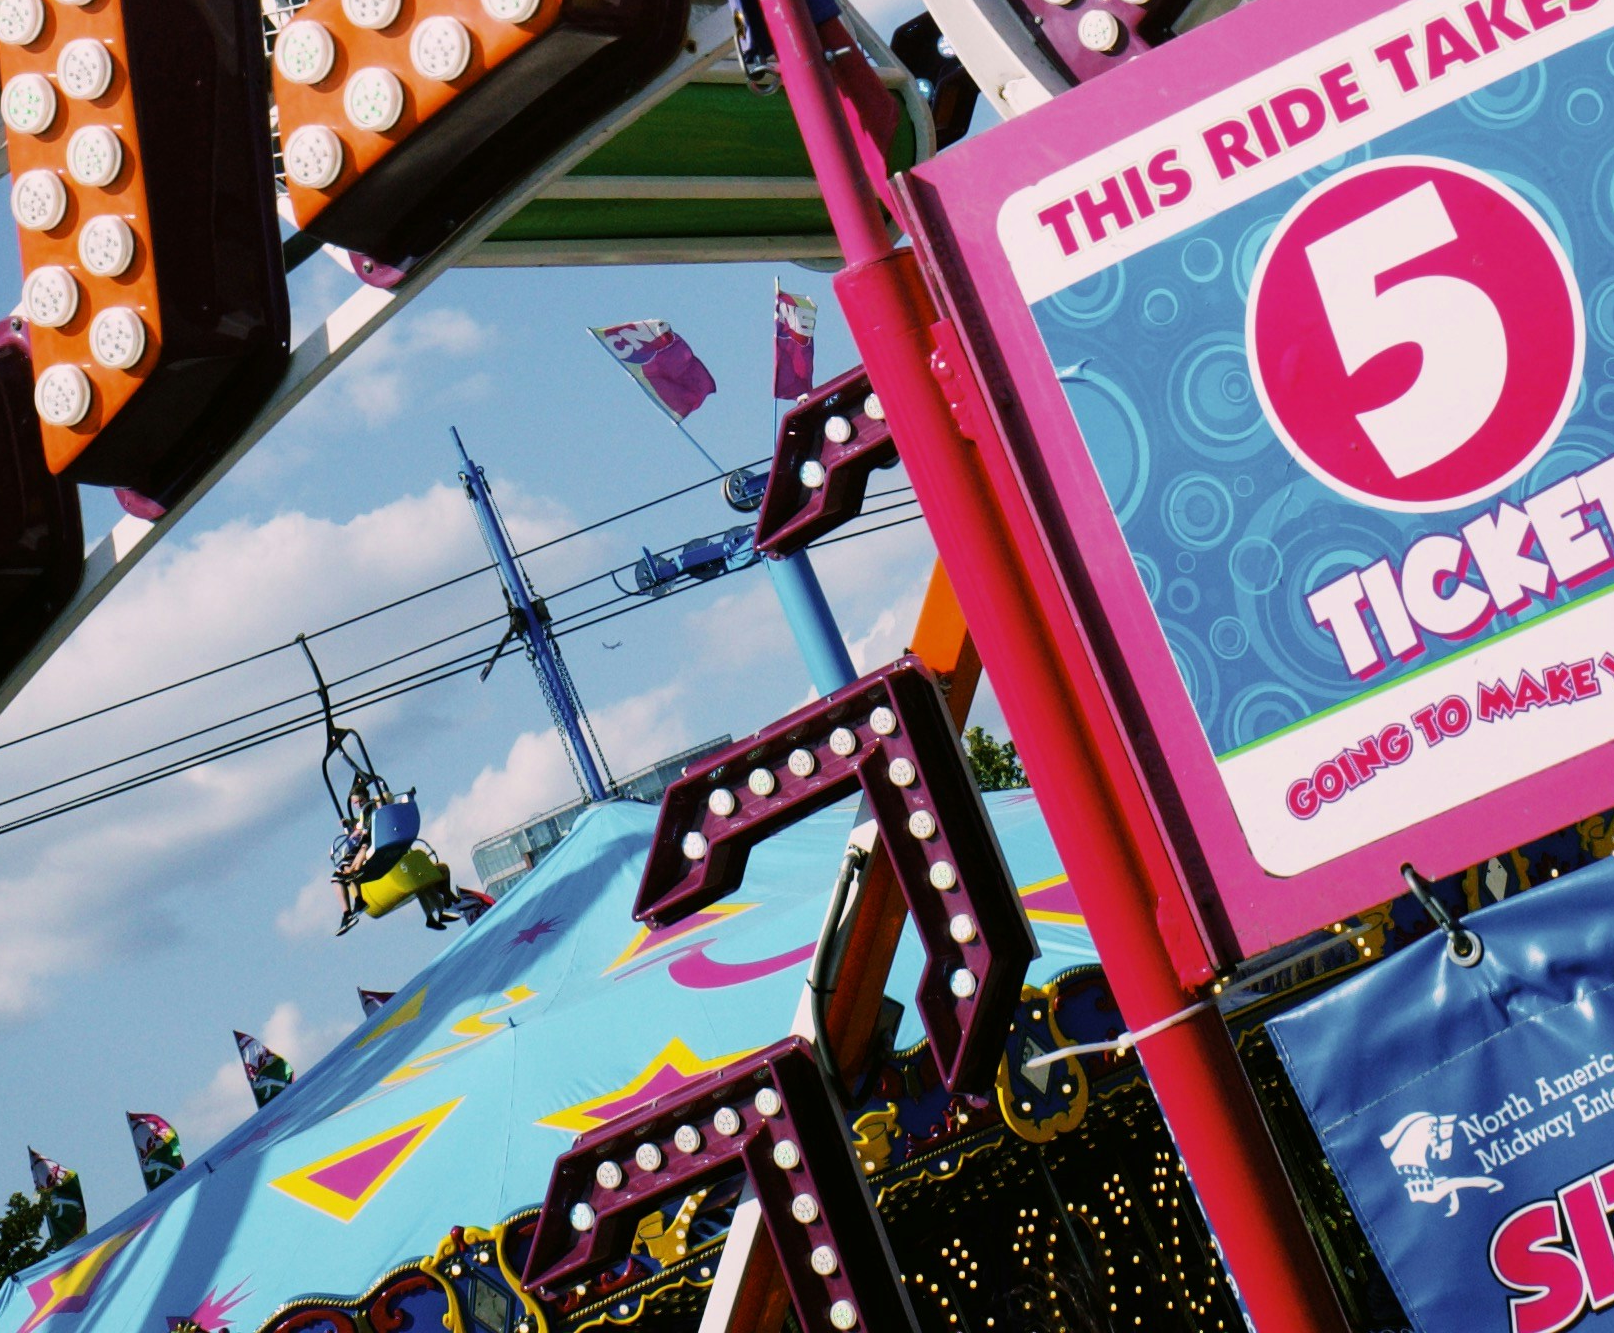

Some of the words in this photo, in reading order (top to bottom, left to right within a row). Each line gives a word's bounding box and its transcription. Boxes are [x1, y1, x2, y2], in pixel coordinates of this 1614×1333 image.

[1036, 148, 1193, 257] THIS
[1201, 61, 1370, 181] RIDE
[1303, 179, 1510, 480] 5
[1286, 723, 1414, 821] GOING
[1410, 694, 1472, 748] TO
[1477, 658, 1602, 723] MAKE
[1458, 1091, 1534, 1145] North
[1474, 1109, 1576, 1174] Midway
